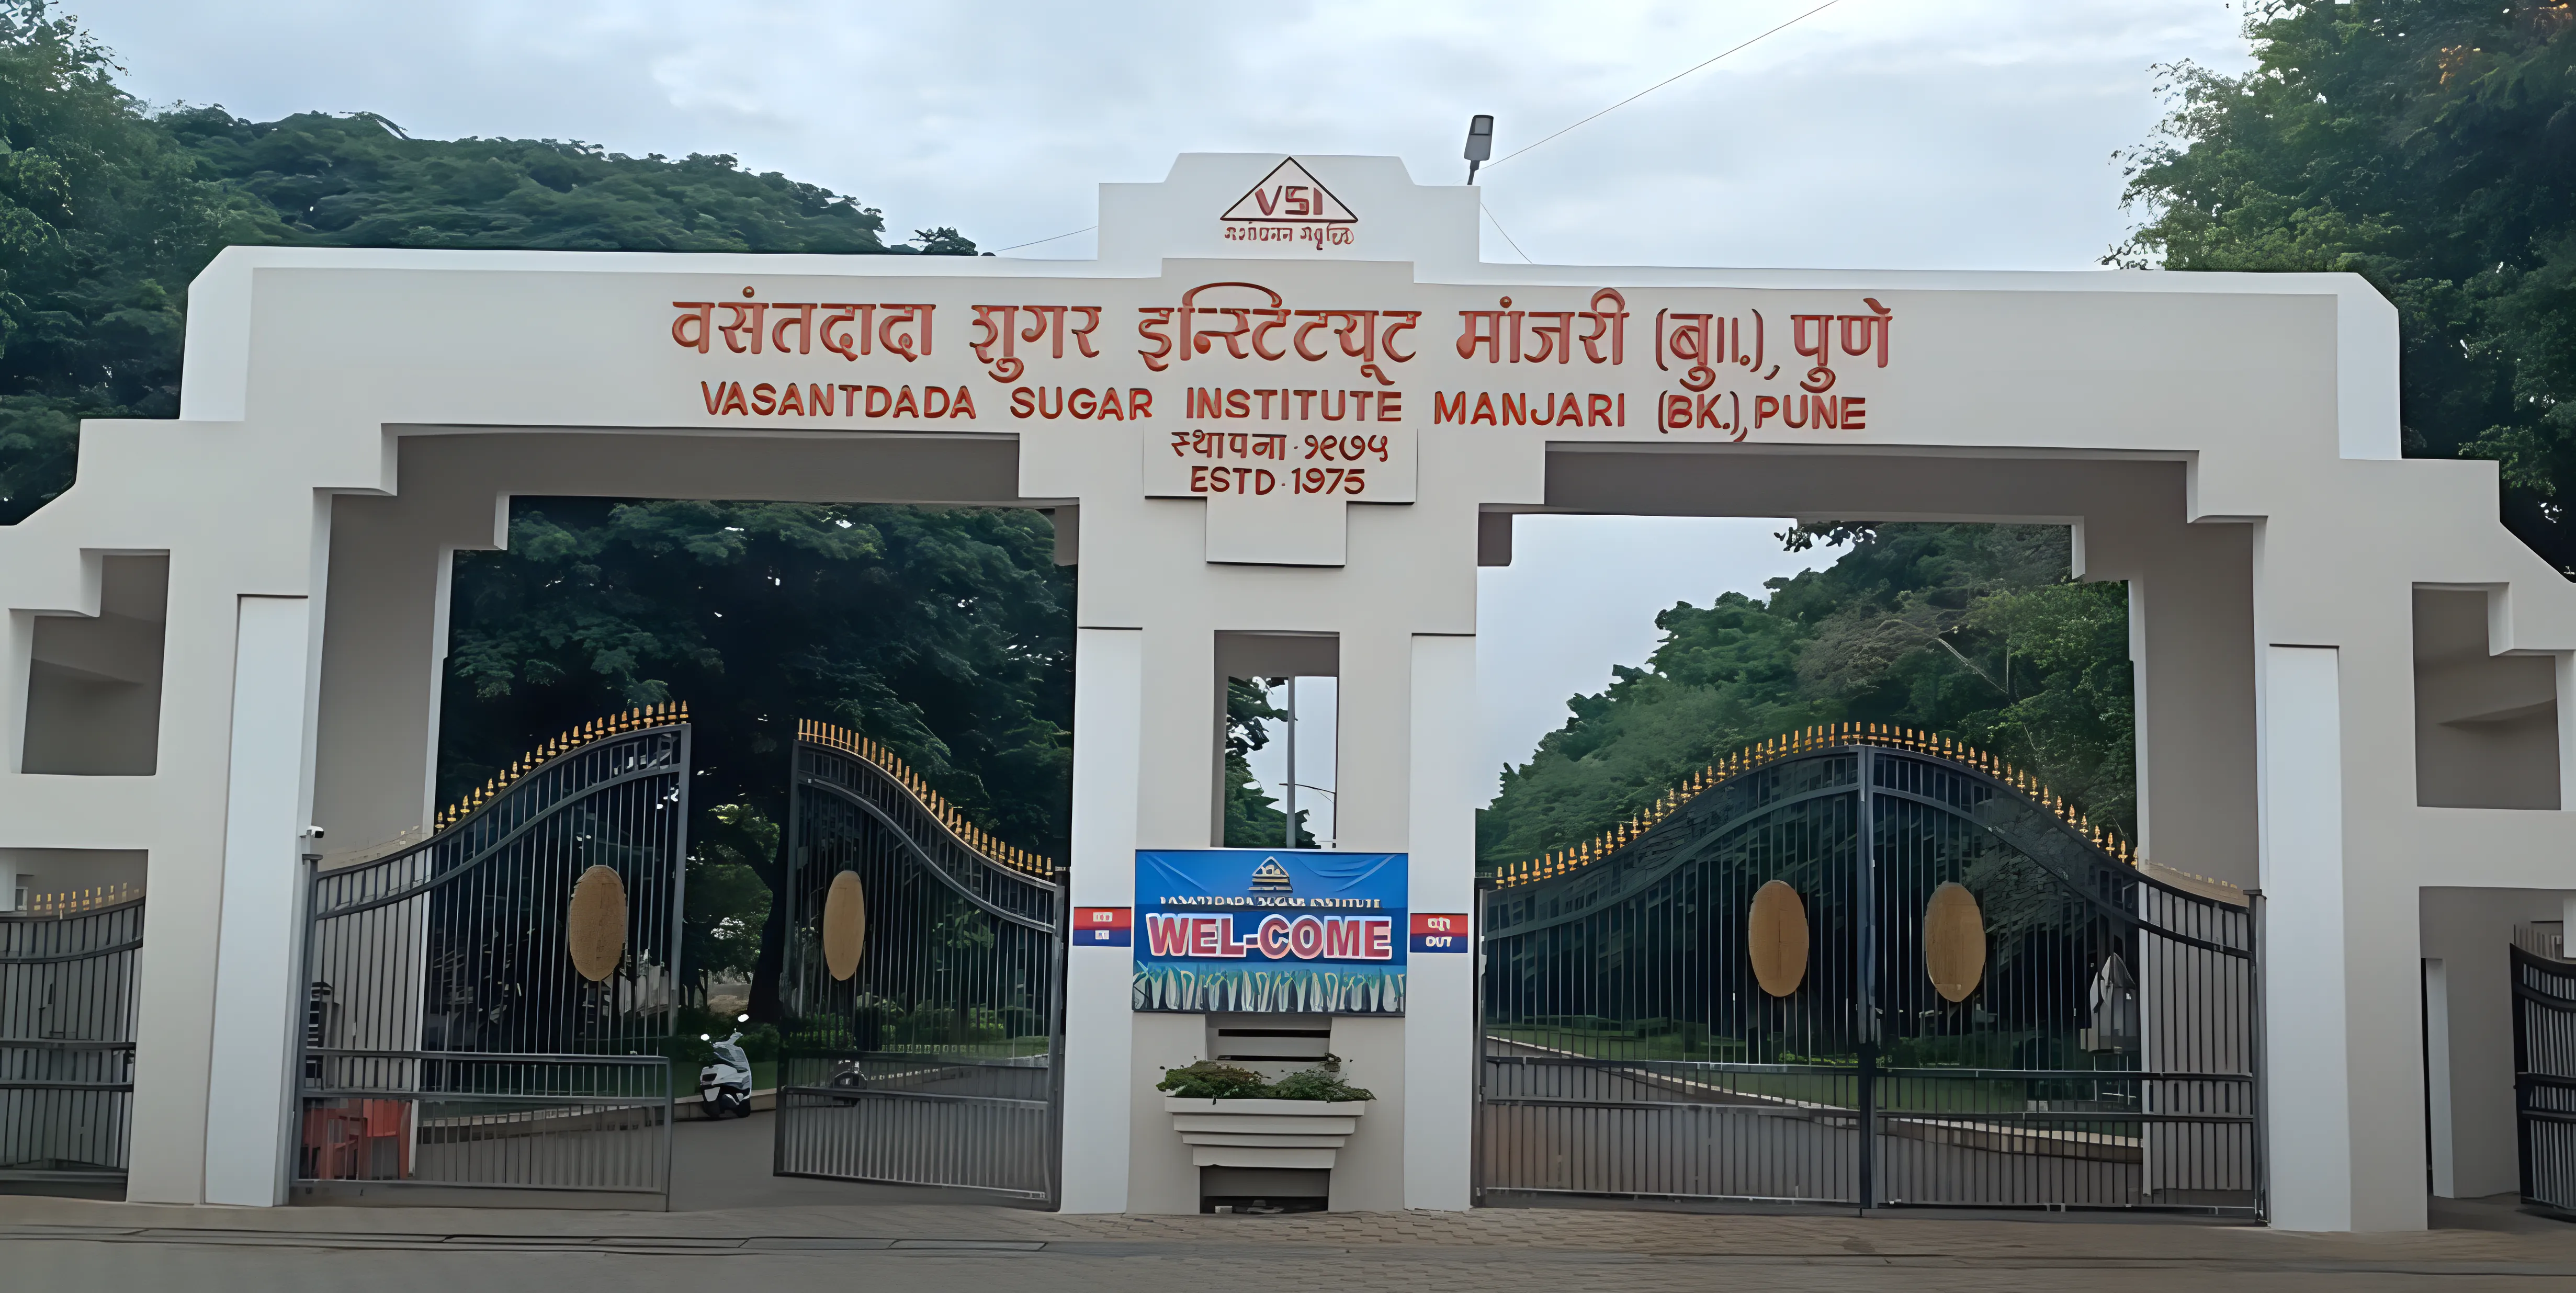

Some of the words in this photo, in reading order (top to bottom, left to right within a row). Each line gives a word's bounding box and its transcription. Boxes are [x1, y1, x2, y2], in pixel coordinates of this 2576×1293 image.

[1255, 185, 1323, 216] VSI
[672, 286, 936, 362] वसंतदादा
[969, 305, 1102, 383] शुगर
[1456, 288, 1630, 365] मांजरी
[1790, 298, 1893, 394] पुणे
[701, 381, 976, 419] VASANTDADA
[1010, 386, 1153, 421] SUGAR
[1186, 387, 1402, 422] INSTITUTE
[1434, 391, 1625, 427] MANJARI
[1754, 394, 1866, 430] PUNE
[1171, 429, 1287, 461] स्थापना
[1304, 434, 1388, 462] १९७५
[1291, 467, 1365, 495] 1975
[1145, 913, 1393, 960] WEL-COME
[1426, 936, 1452, 947] OUT
